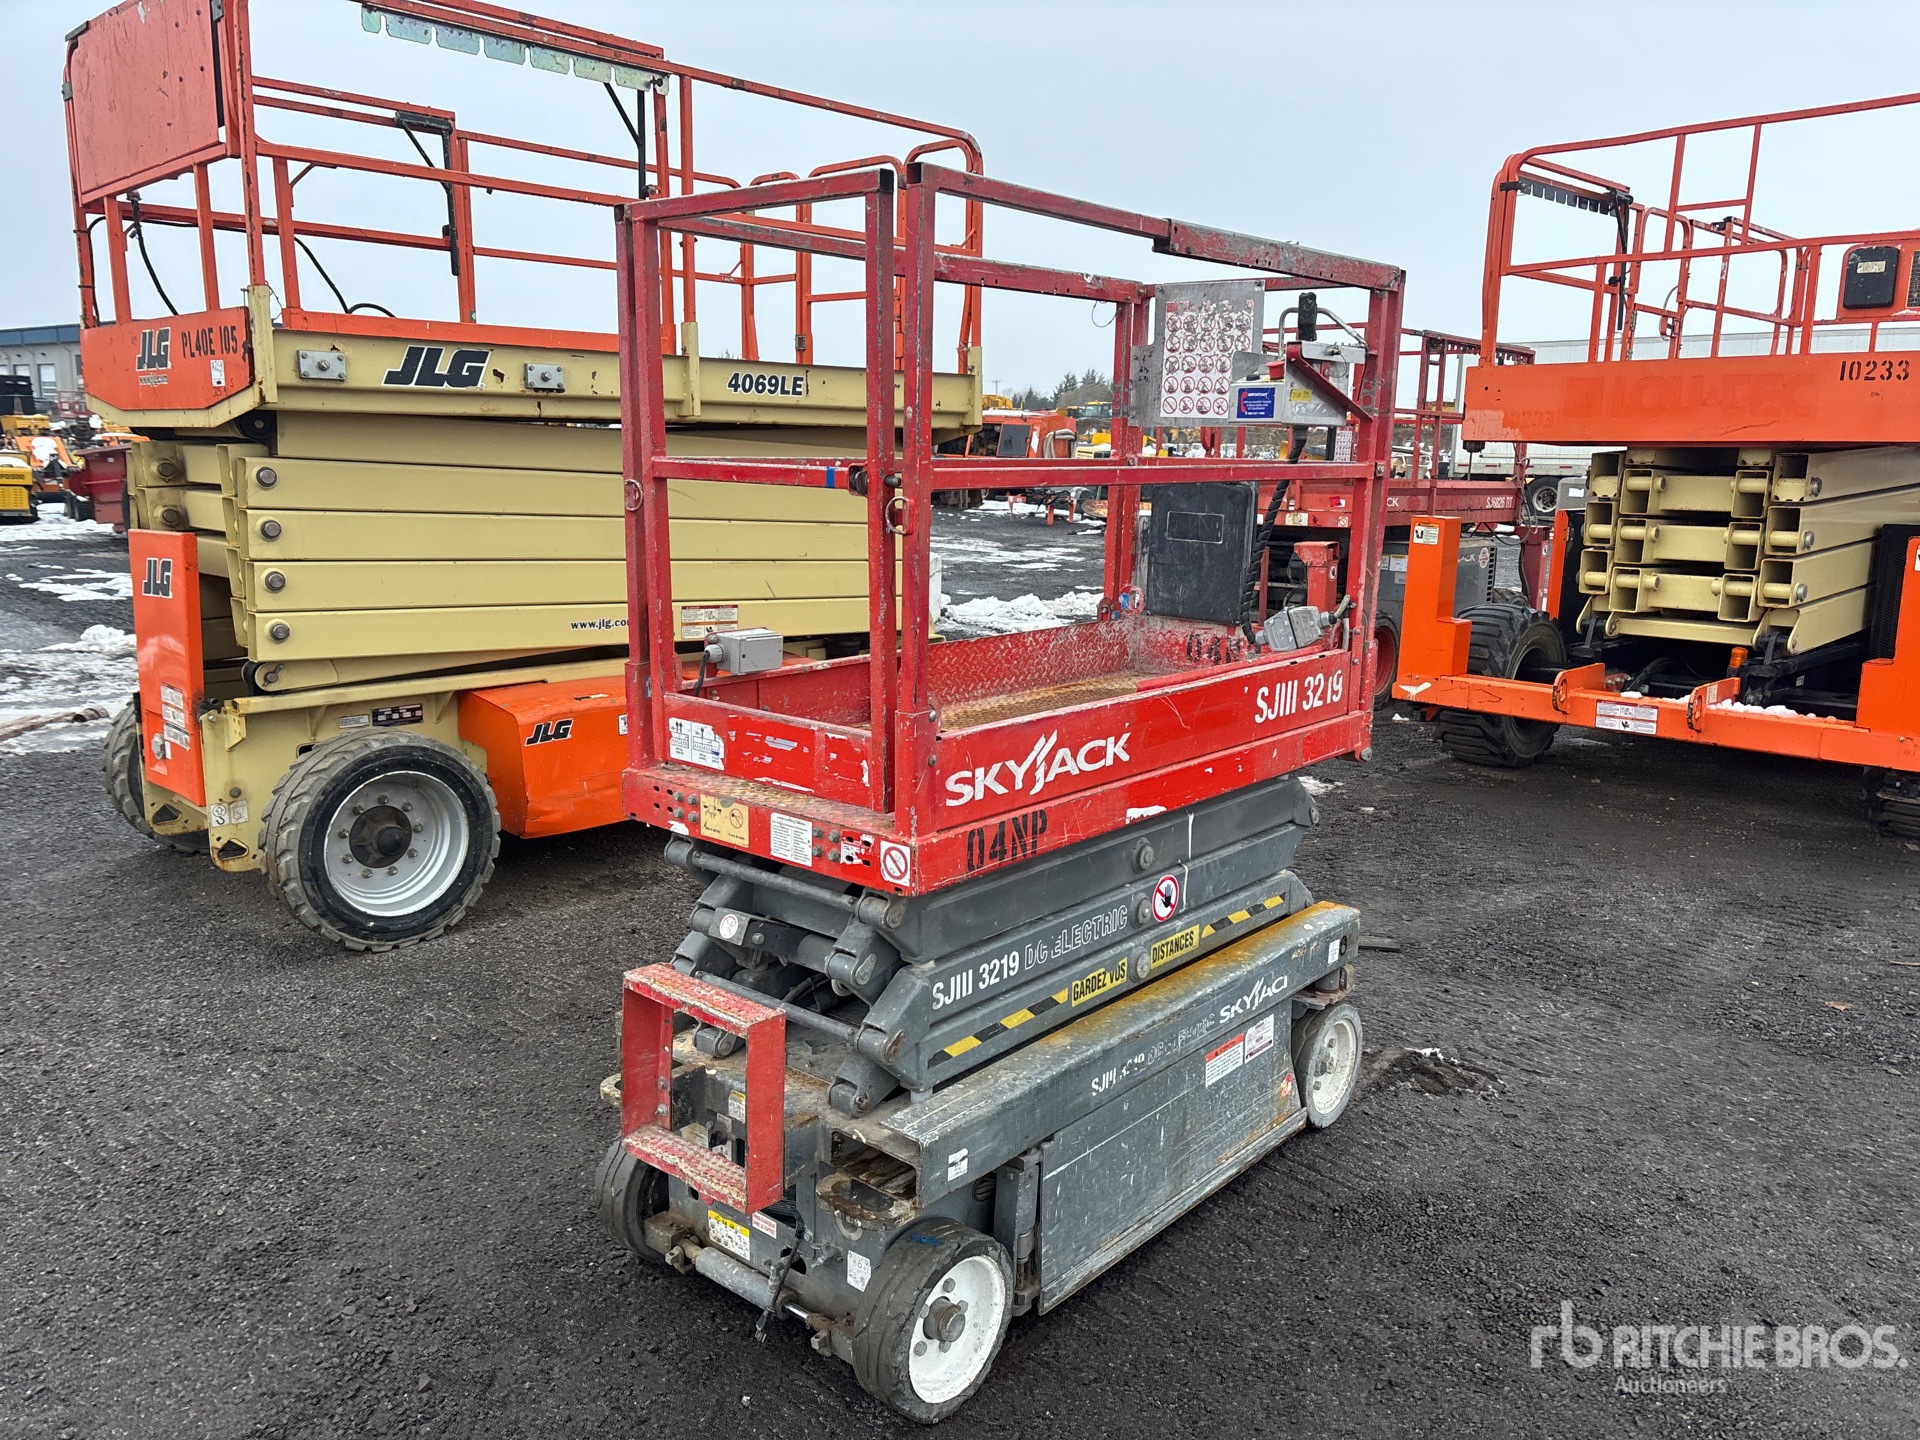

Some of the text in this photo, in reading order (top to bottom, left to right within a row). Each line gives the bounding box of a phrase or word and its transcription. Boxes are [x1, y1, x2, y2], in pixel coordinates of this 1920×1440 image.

[136, 327, 172, 371] JLG
[219, 326, 238, 354] 105
[381, 345, 491, 389] JLG
[727, 372, 804, 396] 4069LE
[1840, 360, 1910, 381] 10233
[142, 558, 172, 598] JLG
[1302, 669, 1343, 711] 3219
[524, 719, 573, 746] JLG
[945, 729, 1131, 807] SKYJACK
[967, 809, 1048, 872] 04NP
[978, 951, 1020, 990] 3219
[1051, 905, 1128, 958] ELECTRIC
[1073, 971, 1107, 1001] GARDEZ
[1151, 930, 1194, 963] DISTANCES
